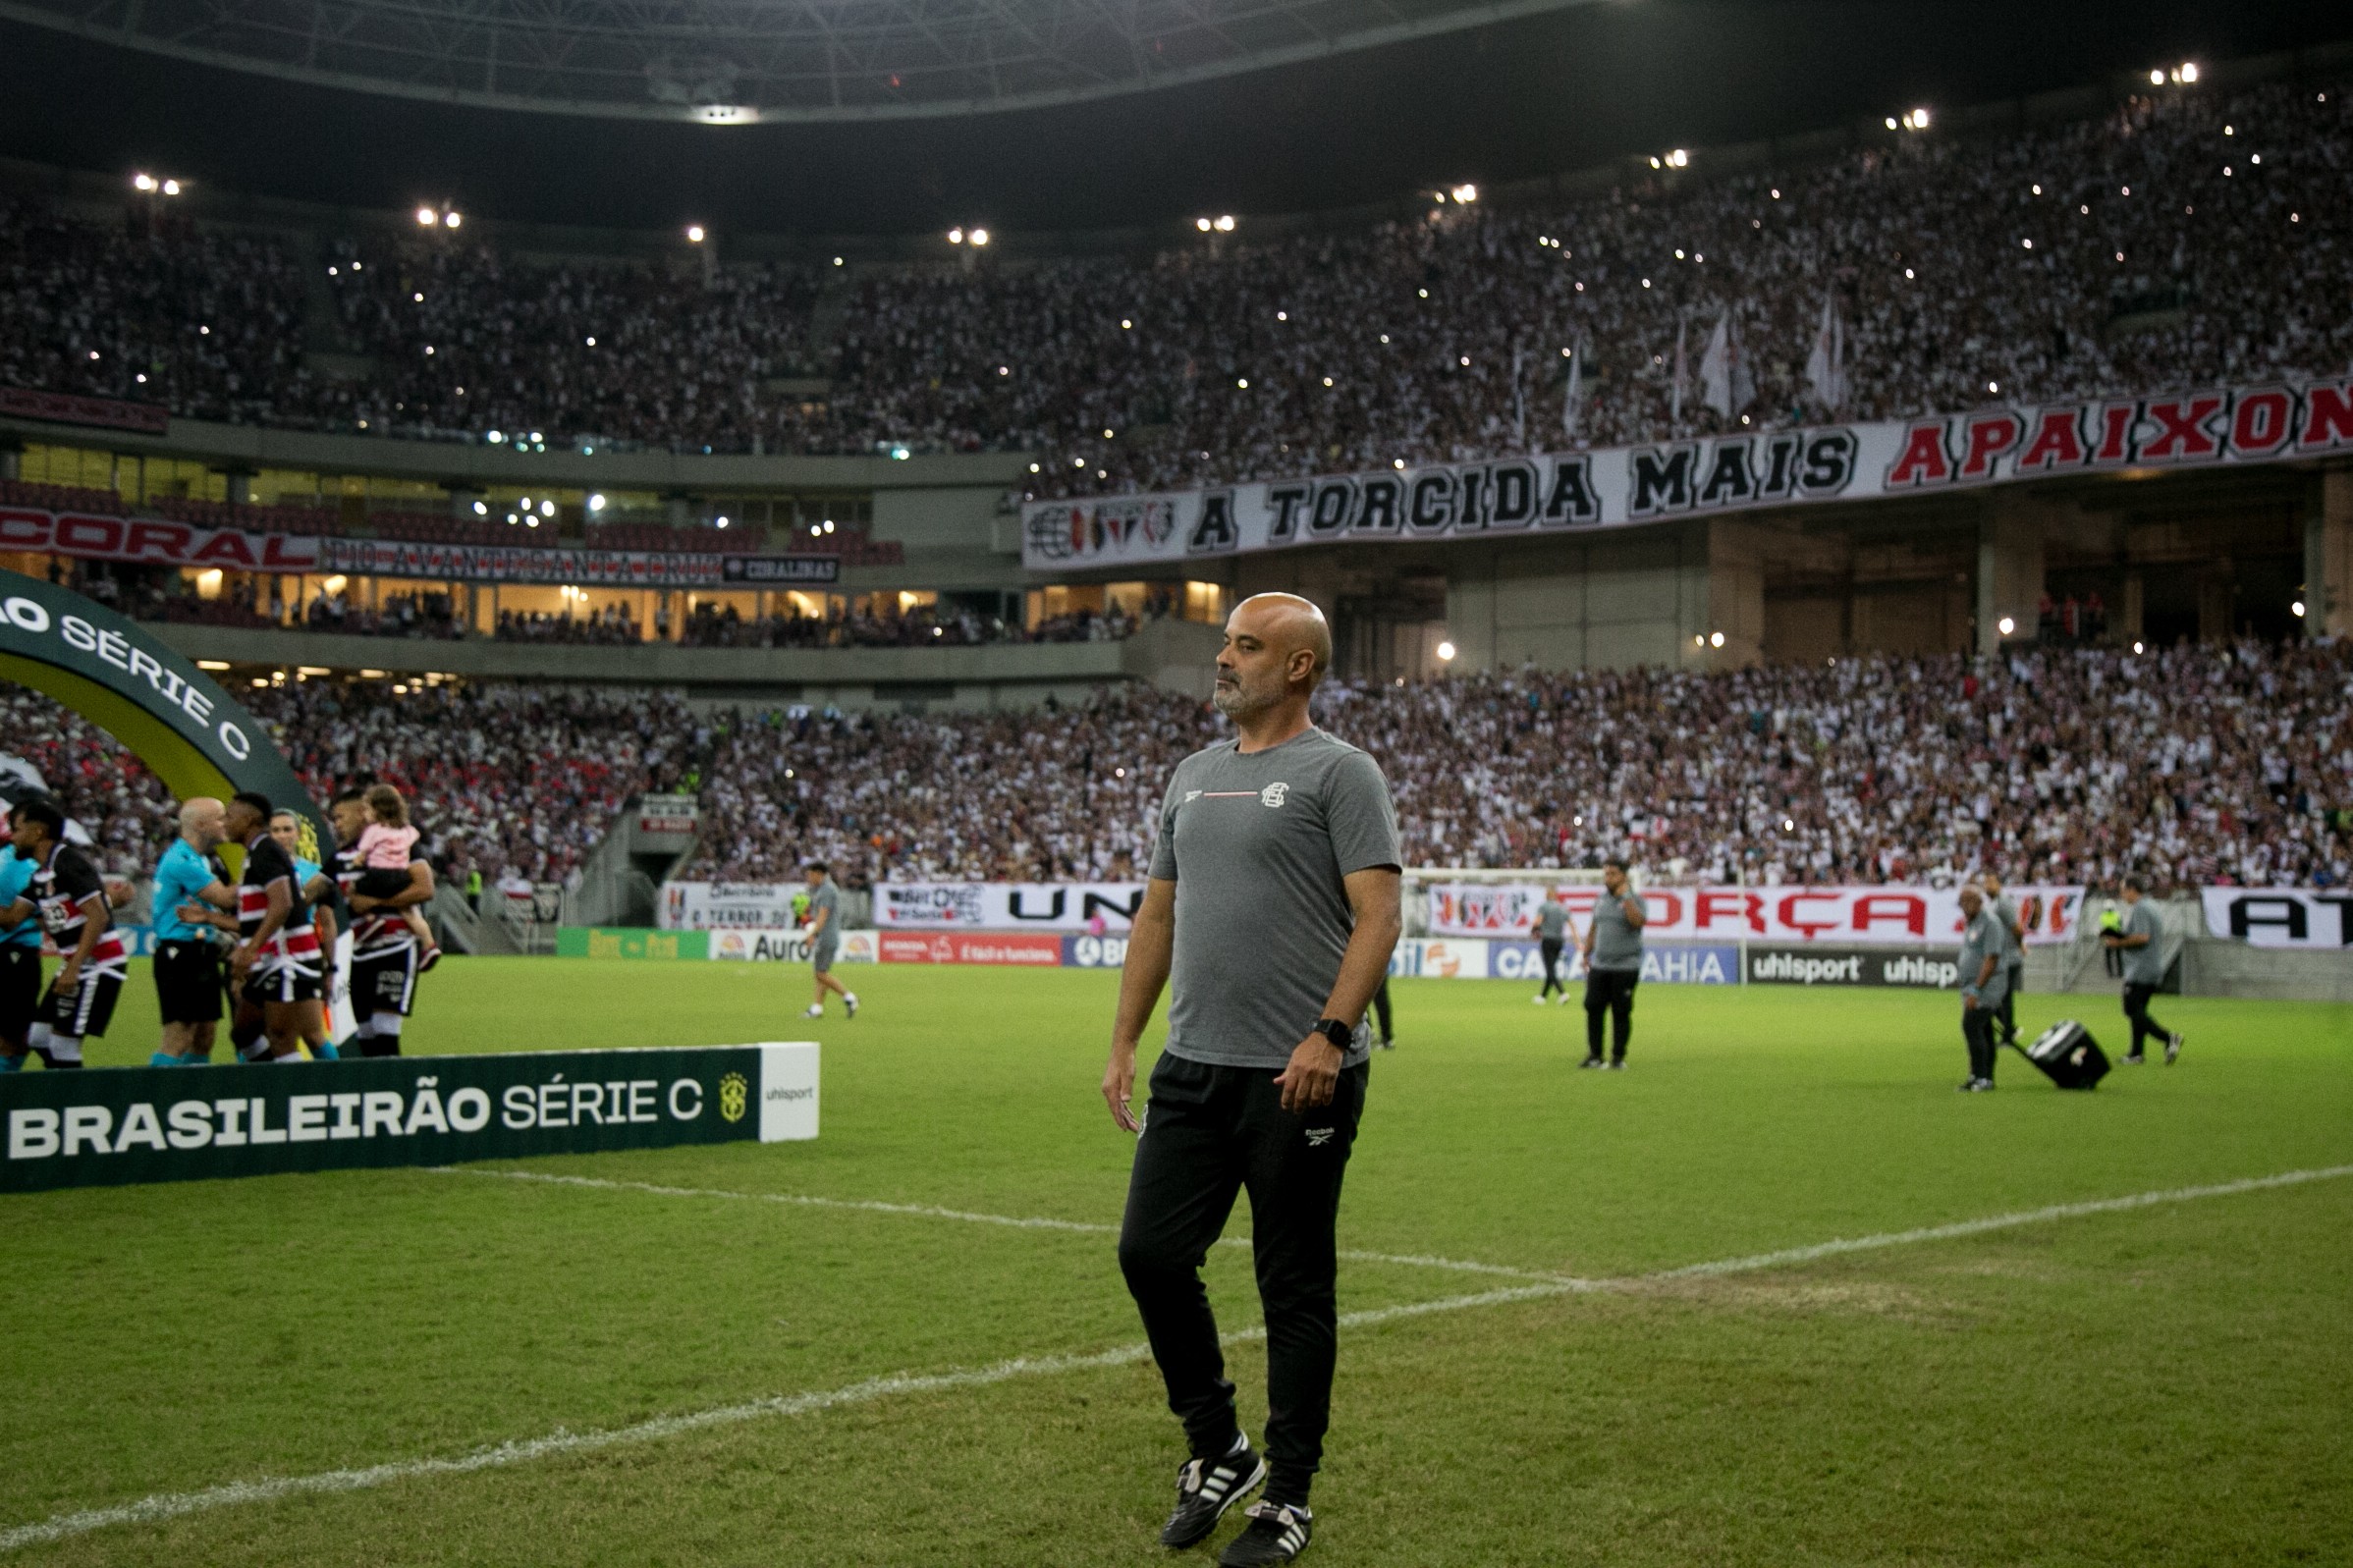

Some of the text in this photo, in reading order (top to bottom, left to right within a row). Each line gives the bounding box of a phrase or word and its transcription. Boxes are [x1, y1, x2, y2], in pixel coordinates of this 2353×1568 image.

[1186, 381, 2353, 553] A TORCIDA MAIS APAIXON
[0, 509, 318, 568] CORAL
[0, 597, 250, 761] O SÉRIE C
[1639, 950, 1726, 982] AHIA
[1754, 952, 1861, 984] uhlsport
[1884, 953, 1958, 988] uhlsp
[8, 1073, 703, 1160] BRASILEIRÃO SÉRIE C
[765, 1086, 814, 1103] uhlsport
